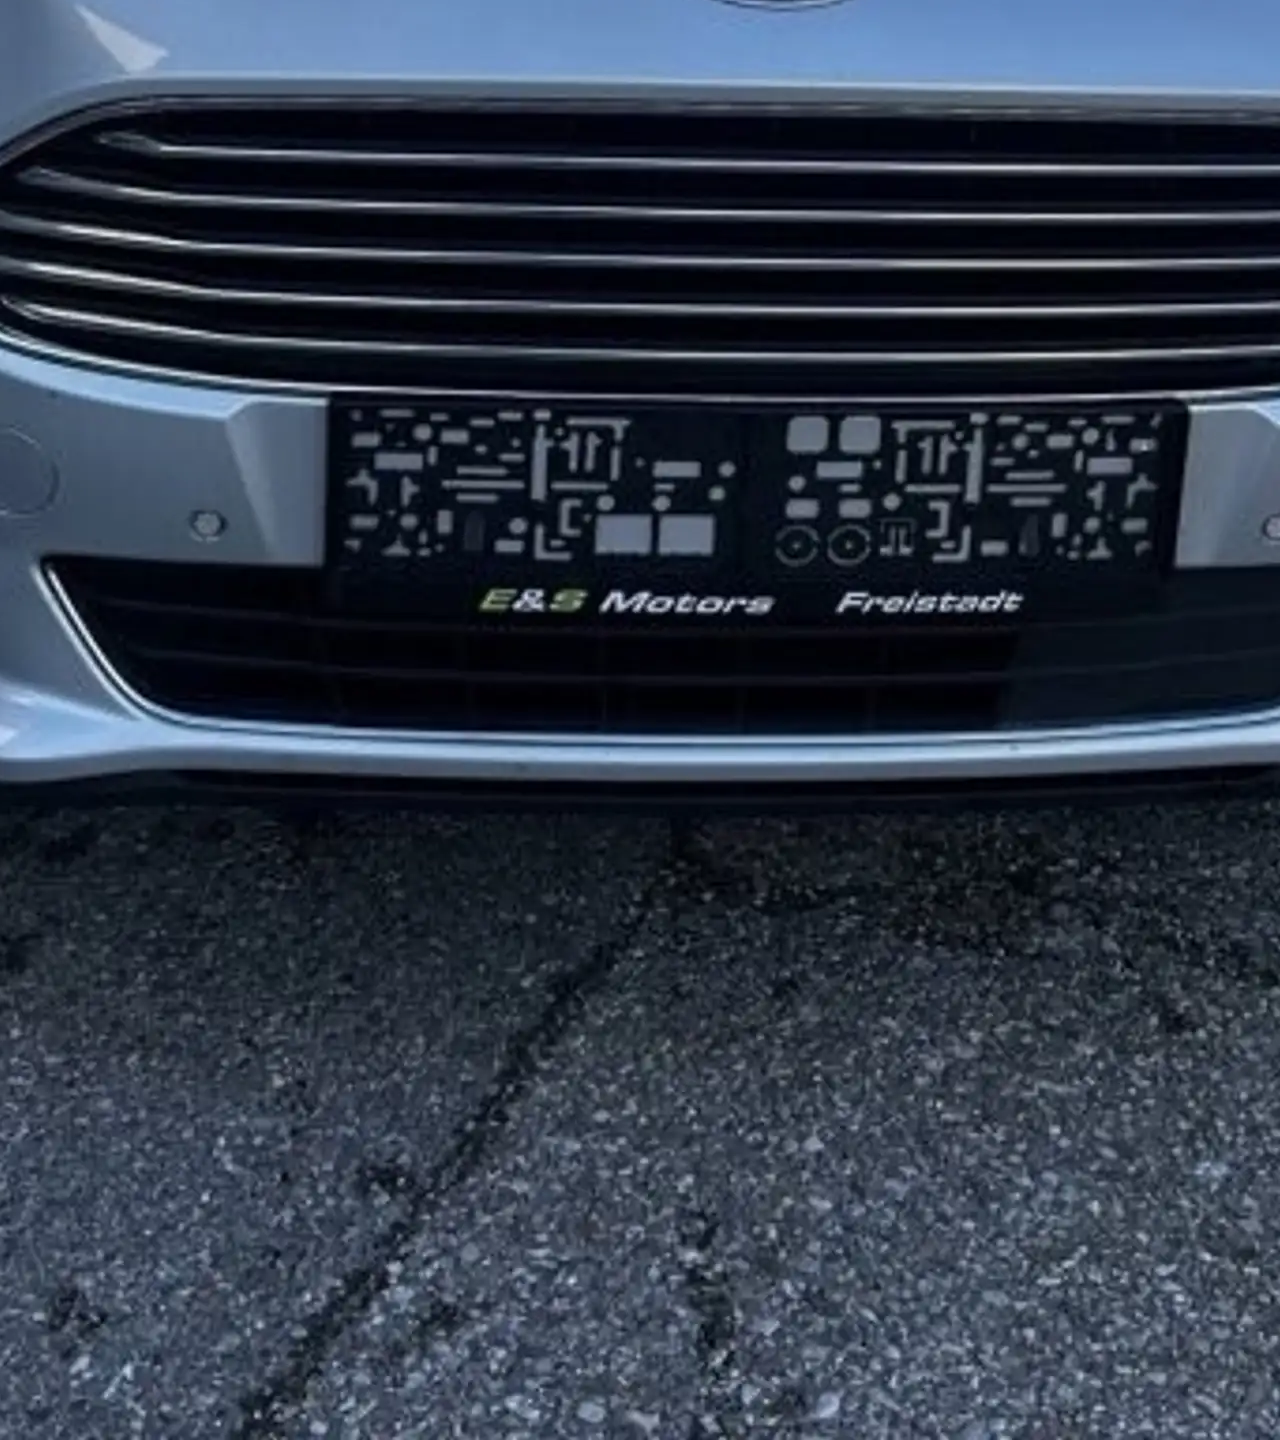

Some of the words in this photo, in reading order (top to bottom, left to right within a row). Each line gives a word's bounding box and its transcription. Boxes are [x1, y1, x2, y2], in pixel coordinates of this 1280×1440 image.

[479, 588, 588, 612] E&S
[599, 589, 776, 615] Motors
[835, 589, 1024, 615] Freistadt
